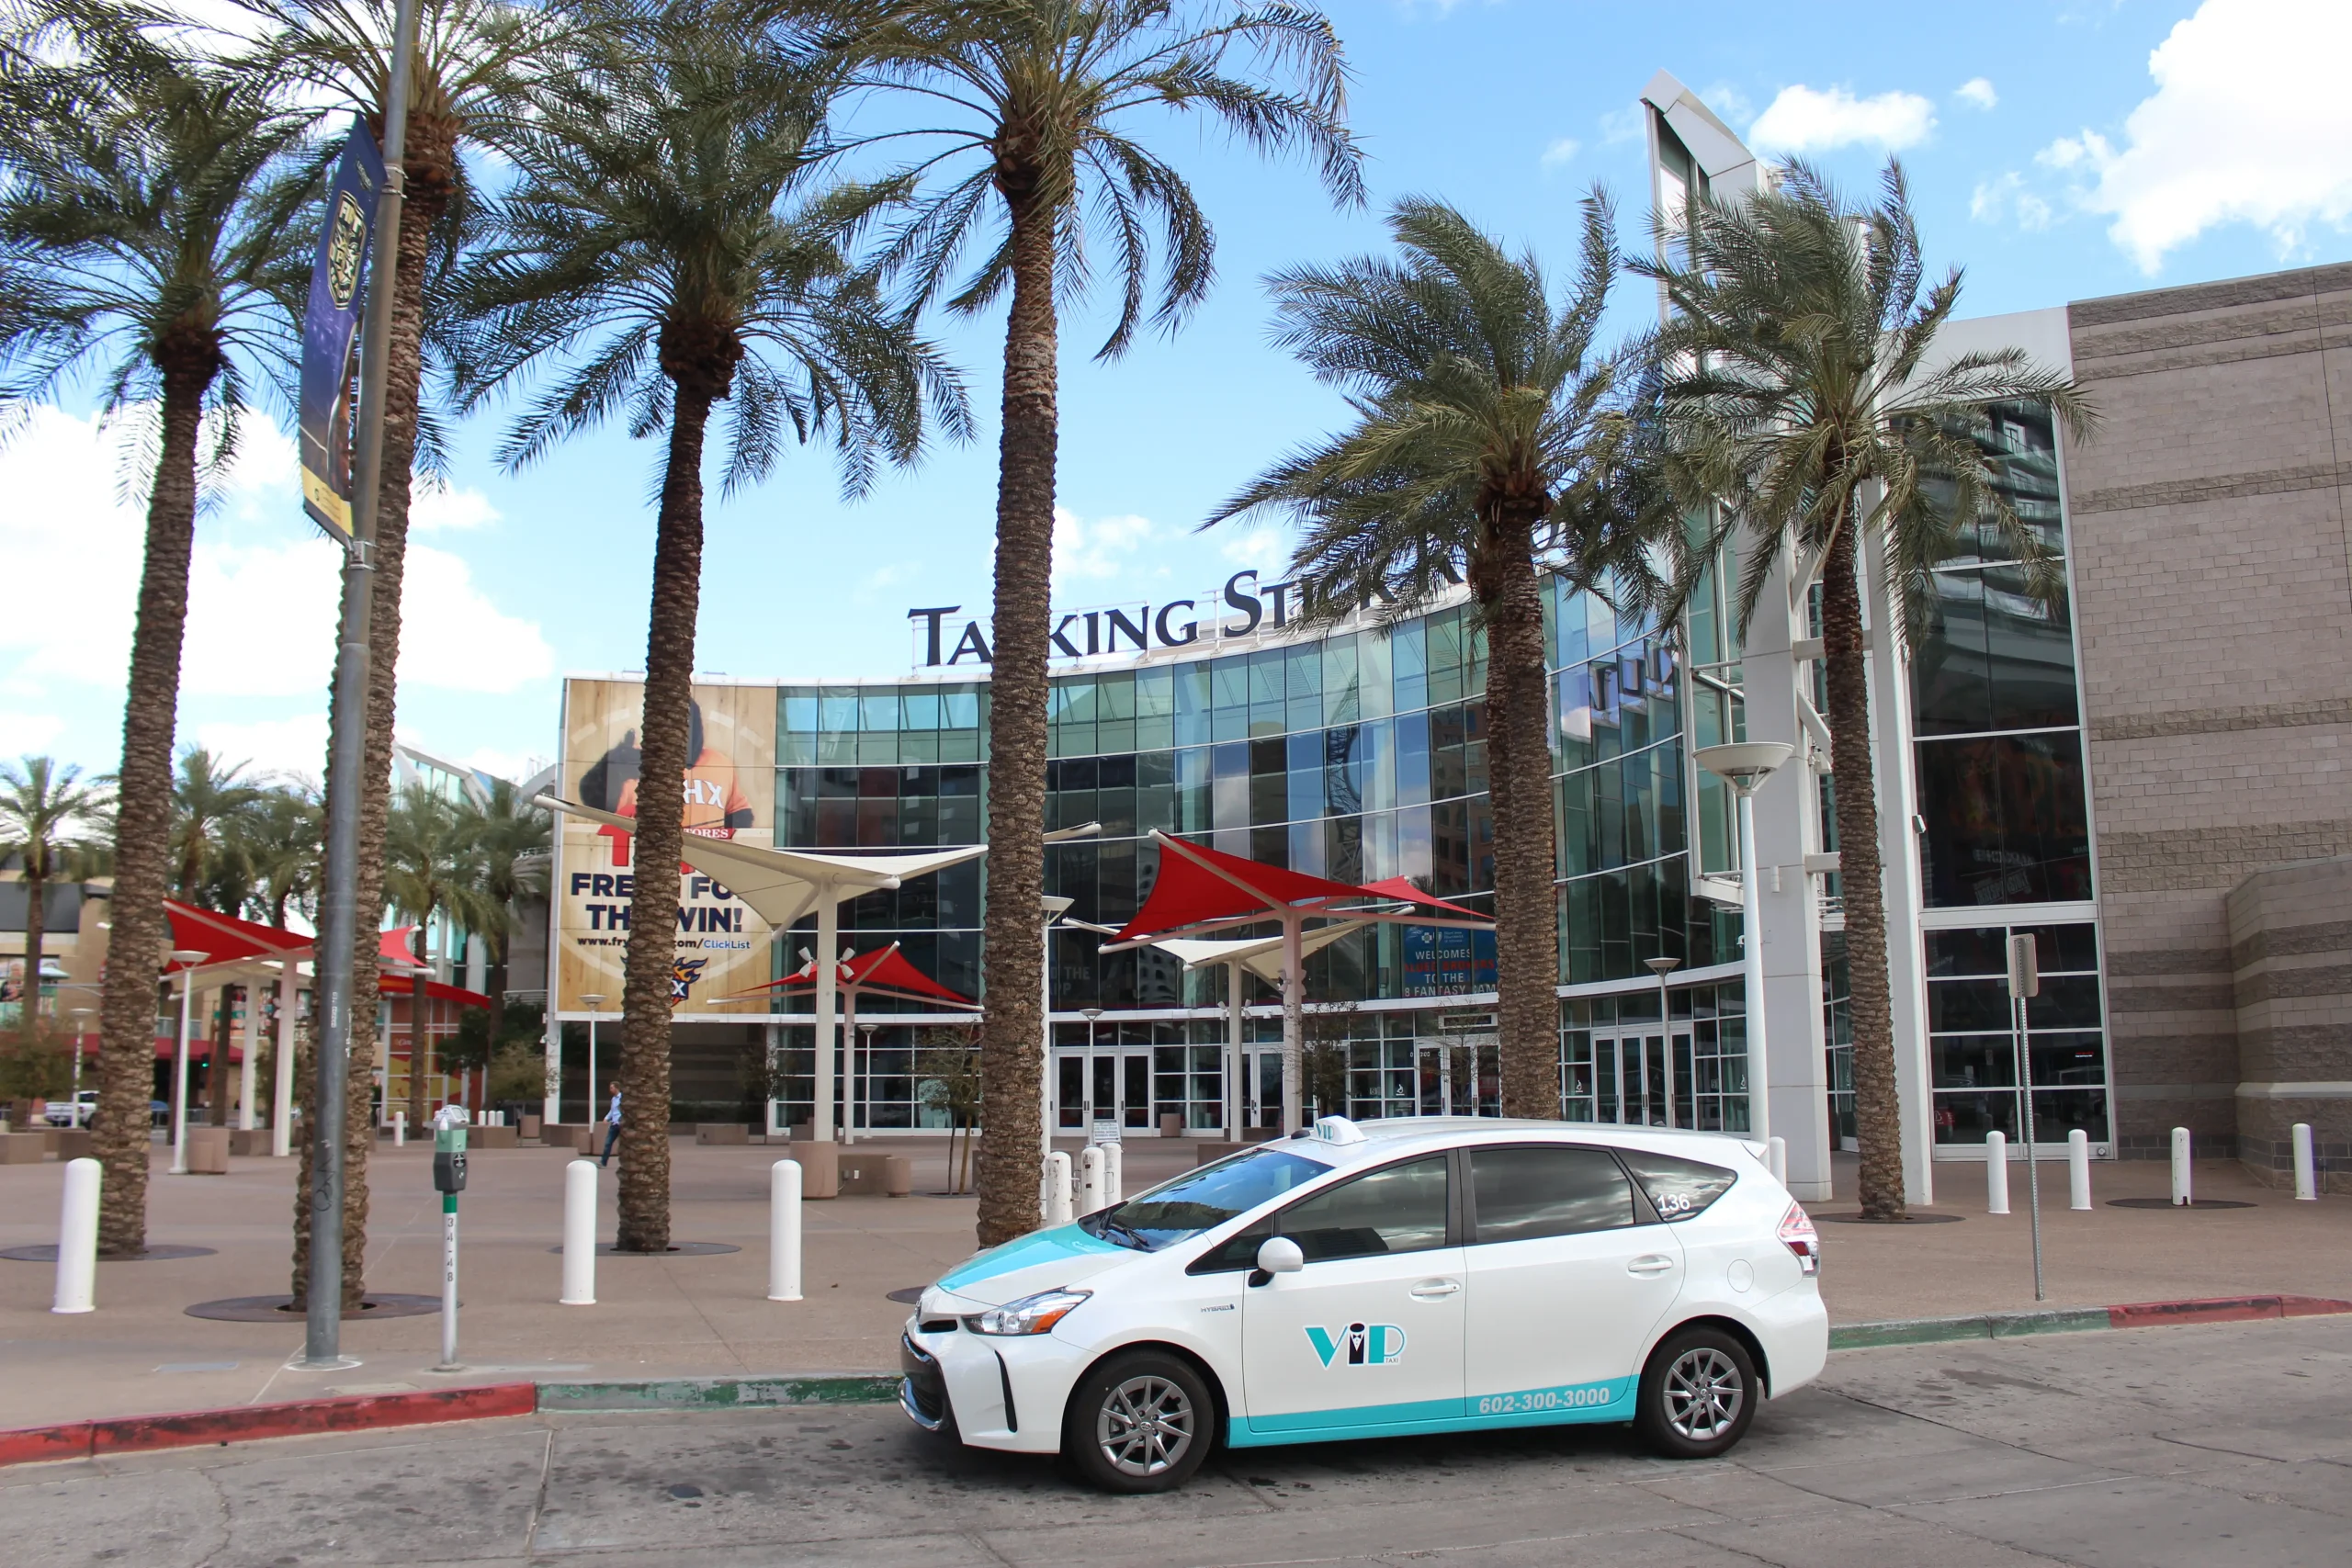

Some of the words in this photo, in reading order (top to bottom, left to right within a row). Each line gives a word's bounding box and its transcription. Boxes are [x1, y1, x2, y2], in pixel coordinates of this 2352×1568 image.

[908, 600, 1199, 667] TAKING
[683, 779, 725, 809] HX
[691, 876, 742, 900] FO
[585, 904, 631, 931] TH
[1442, 973, 1464, 983] THE
[1415, 986, 1466, 997] FANTASY
[1316, 1122, 1334, 1140] VIP
[1657, 1193, 1690, 1212] 136
[1201, 1304, 1230, 1313] HYBRID
[1479, 1387, 1610, 1414] 602-300-3000
